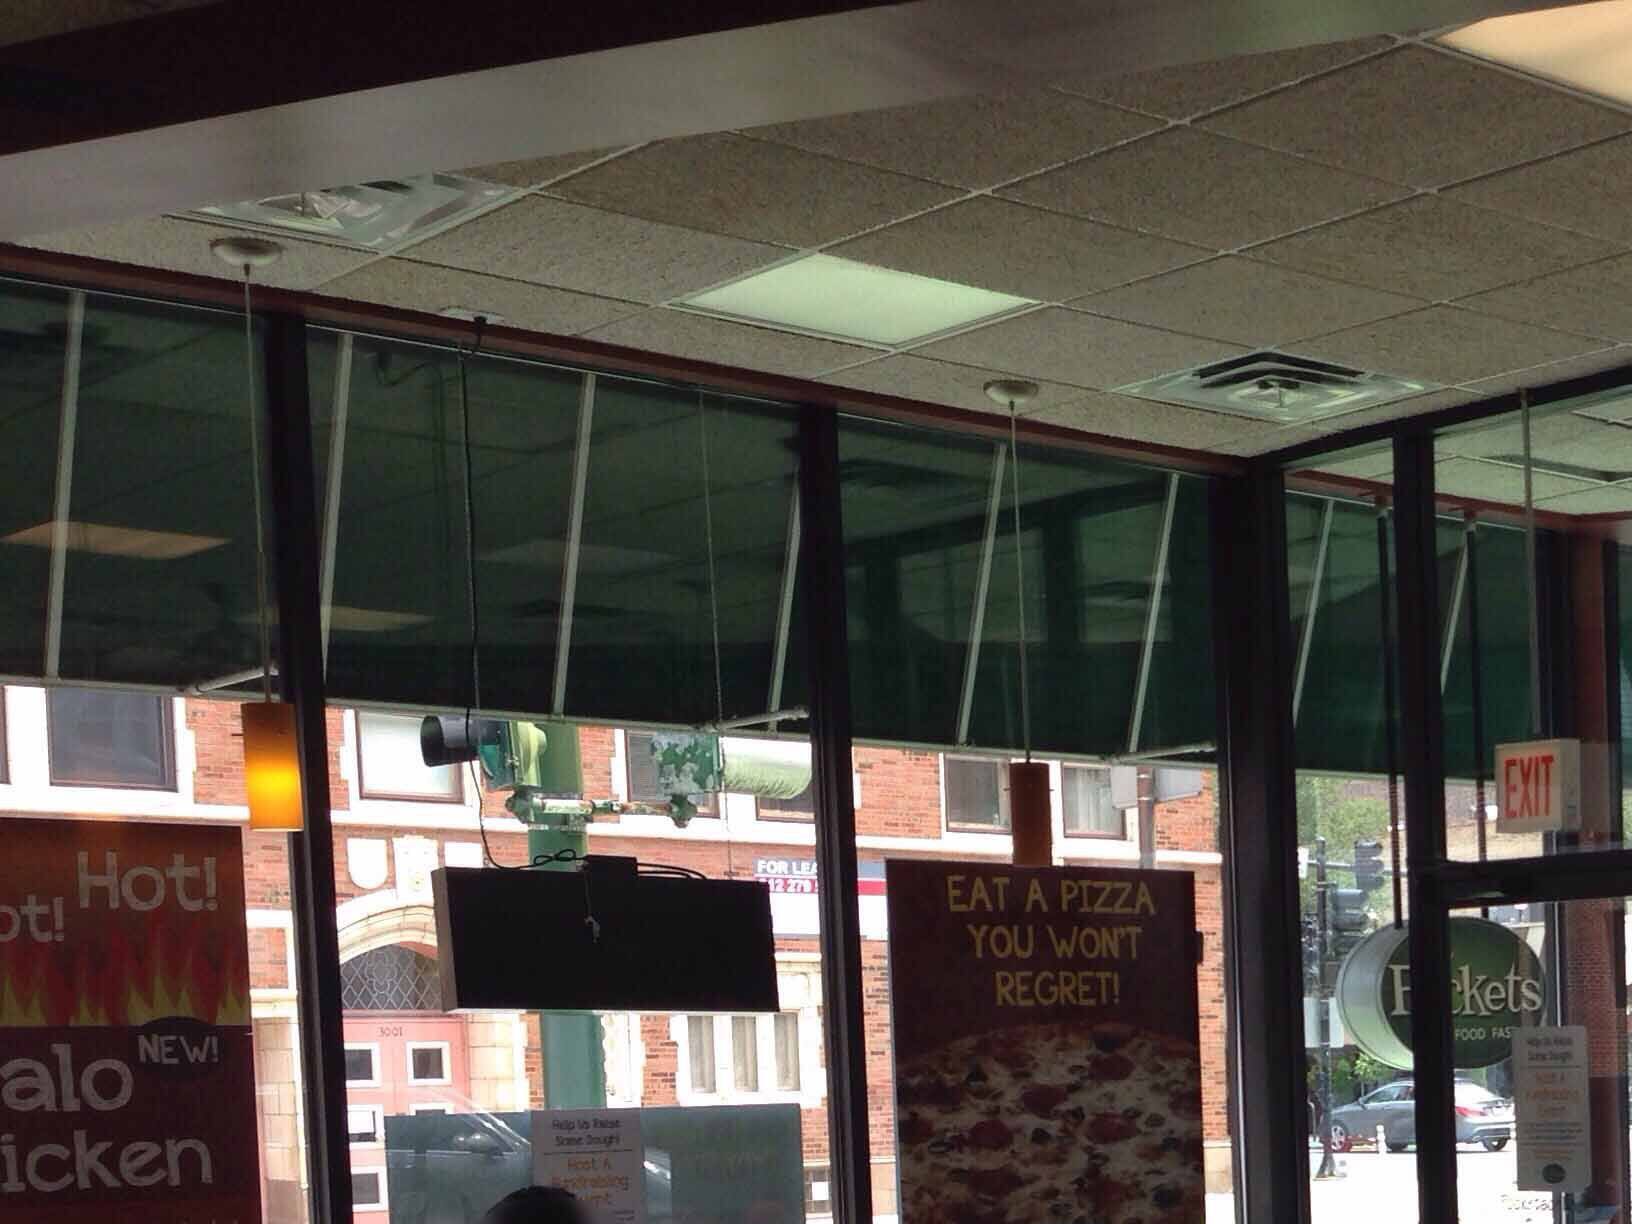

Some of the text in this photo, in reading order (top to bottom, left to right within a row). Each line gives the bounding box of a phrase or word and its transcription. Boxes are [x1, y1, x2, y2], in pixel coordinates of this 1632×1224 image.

[1504, 755, 1554, 817] EXIT
[77, 850, 218, 912] Hot!
[757, 860, 818, 875] FOR LEA
[947, 875, 1156, 915] EAT A PIZZA
[967, 924, 1143, 959] YOU WON'T
[994, 971, 1120, 1006] REGRET!
[1387, 963, 1543, 1017] Pckets
[137, 1034, 219, 1066] NEW!
[1454, 1027, 1487, 1041] FOOD
